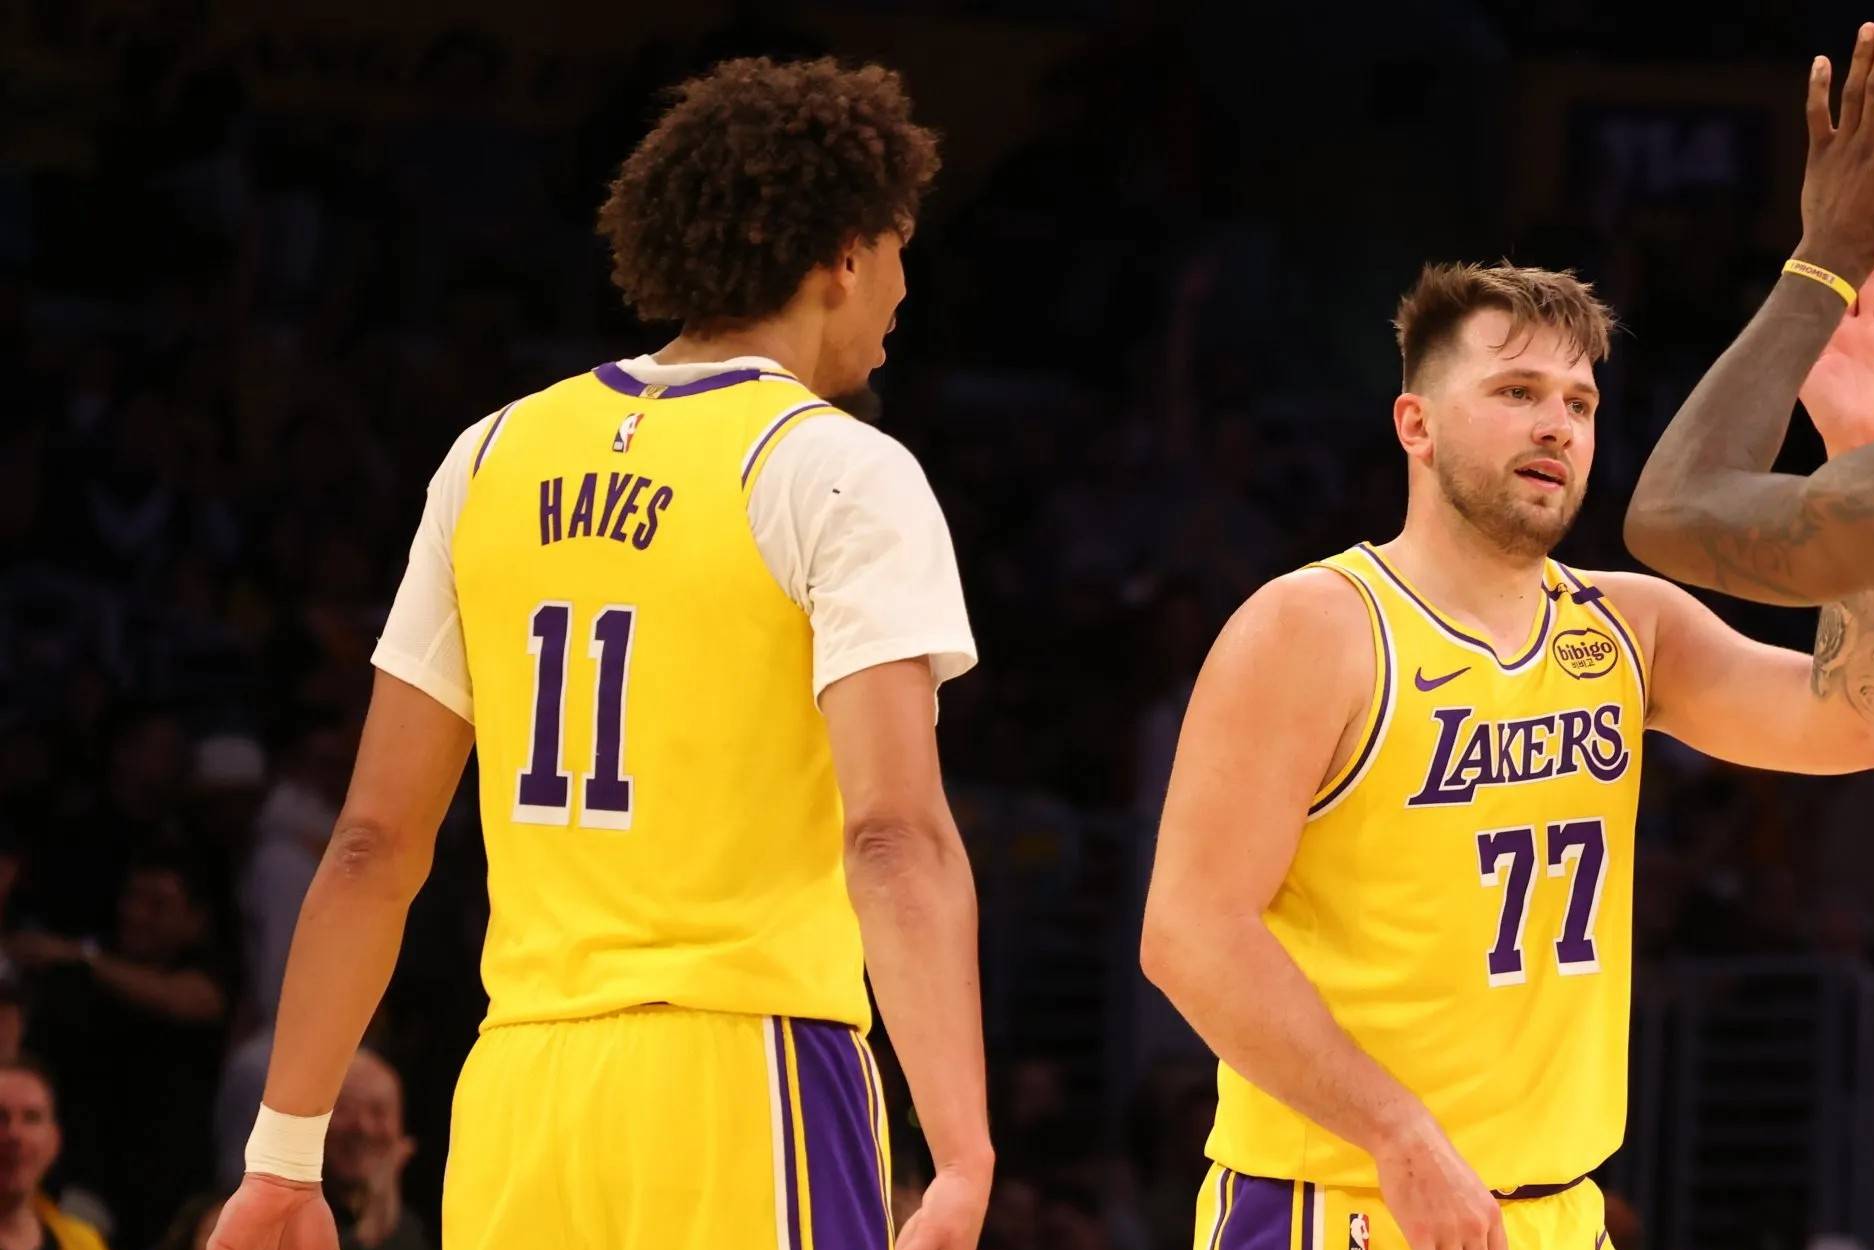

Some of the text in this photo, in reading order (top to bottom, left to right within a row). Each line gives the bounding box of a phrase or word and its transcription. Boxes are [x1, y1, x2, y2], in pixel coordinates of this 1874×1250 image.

[539, 471, 674, 551] HAYES
[1556, 640, 1613, 662] bibigo
[514, 601, 638, 830] 11
[1404, 702, 1632, 808] LAKERS
[1475, 817, 1611, 987] 77
